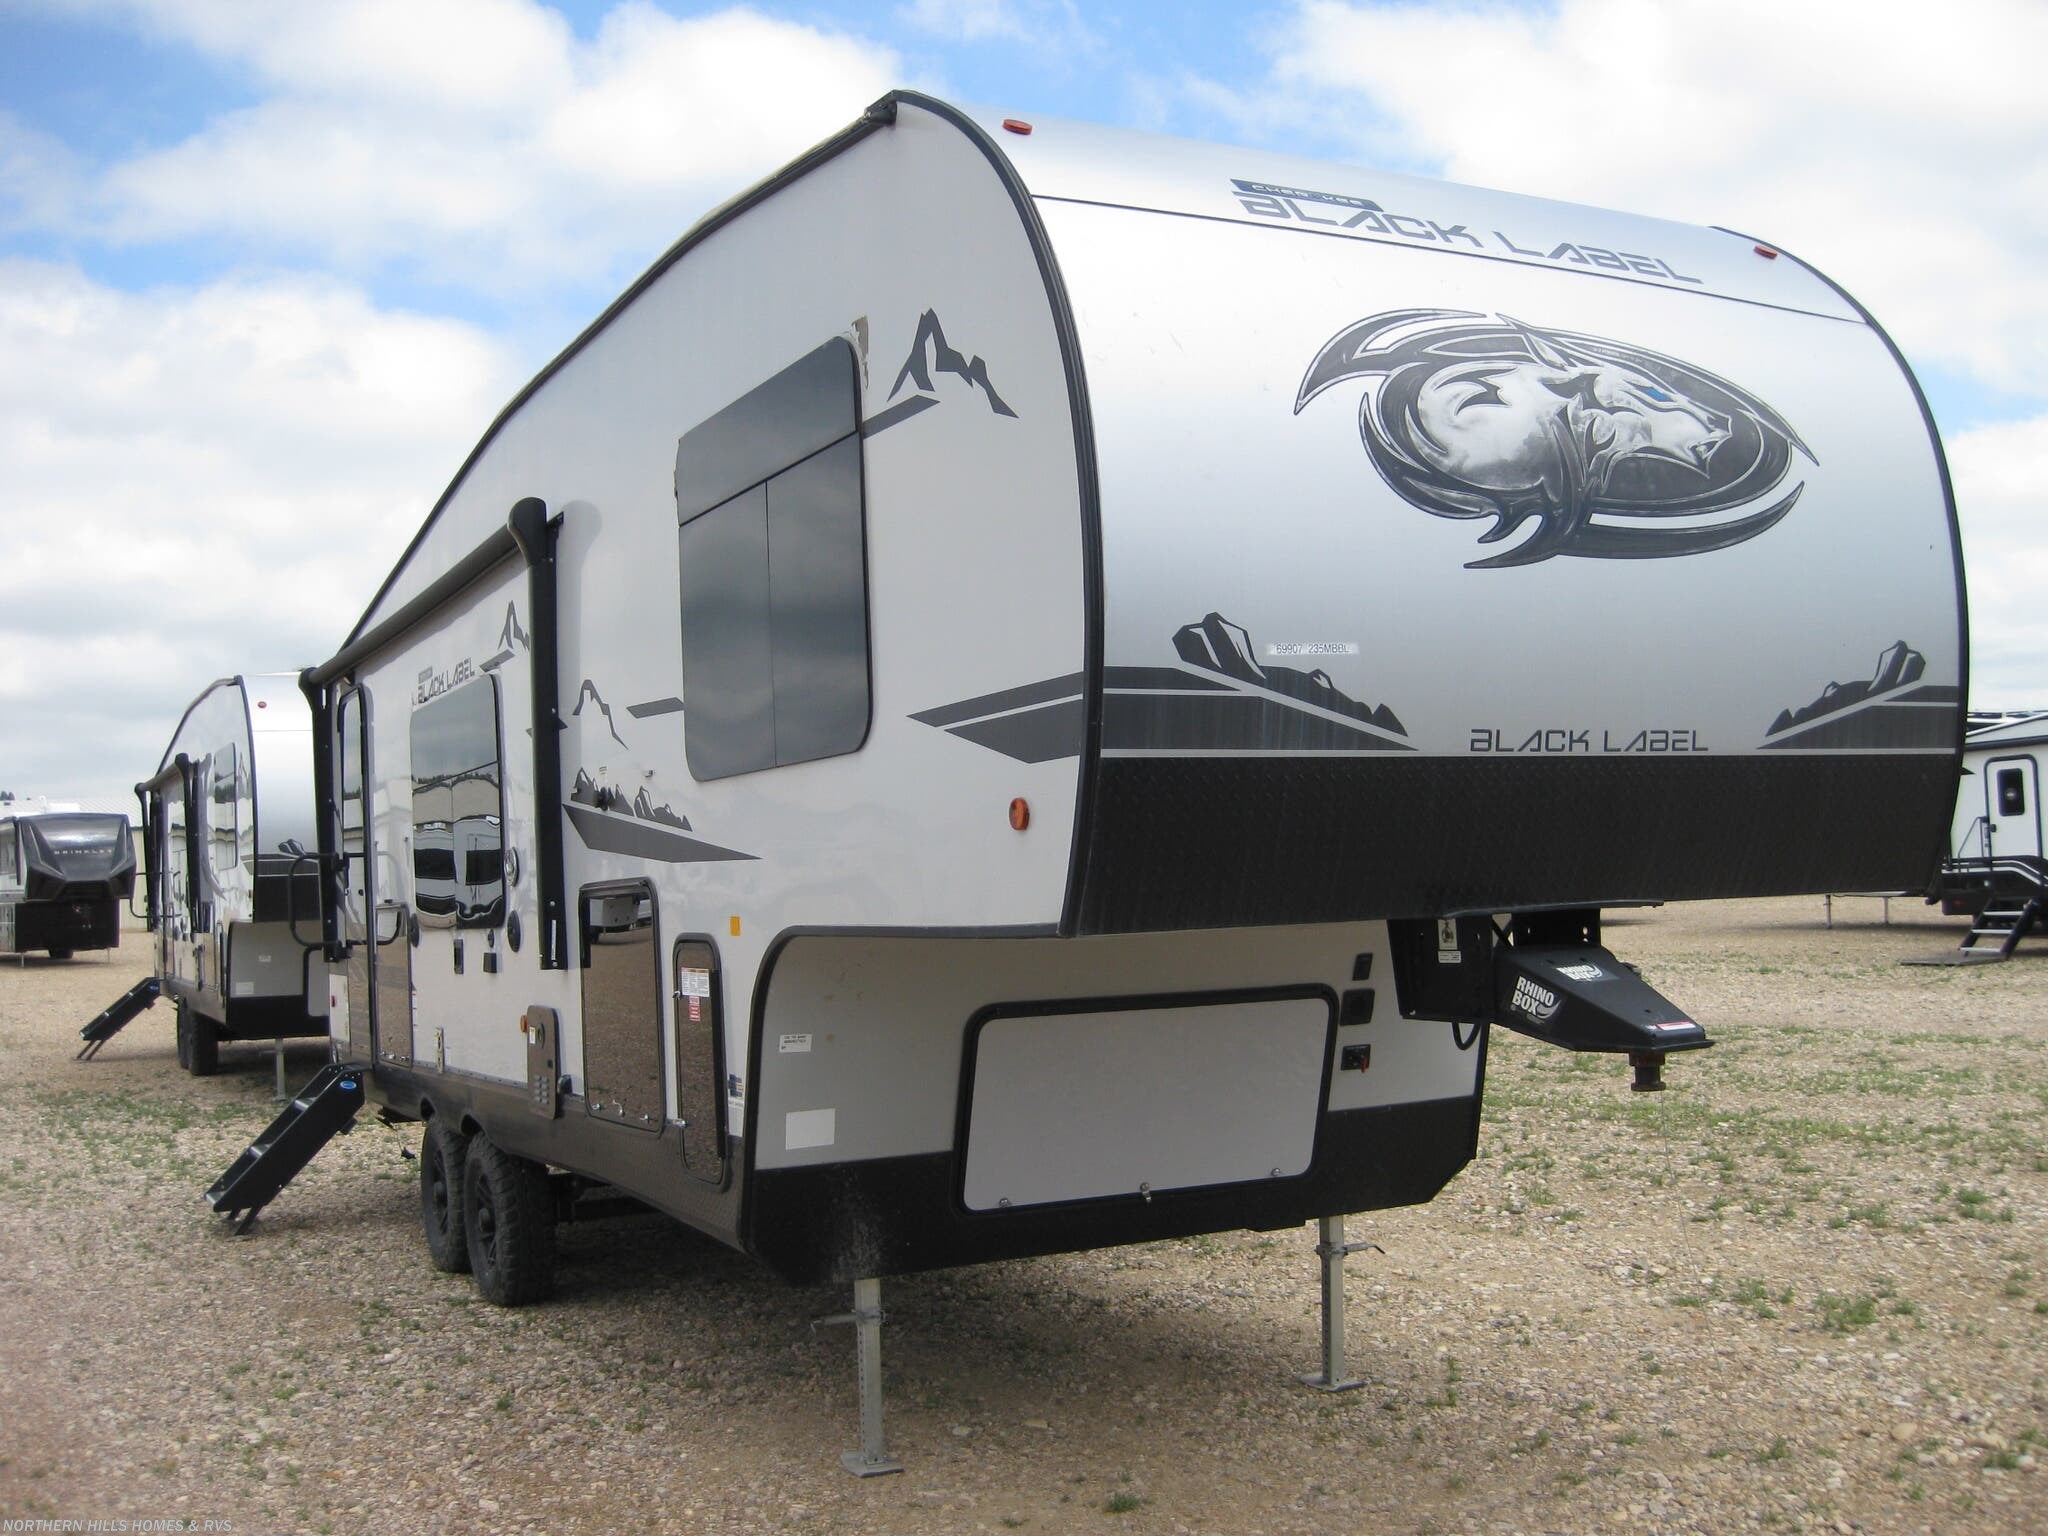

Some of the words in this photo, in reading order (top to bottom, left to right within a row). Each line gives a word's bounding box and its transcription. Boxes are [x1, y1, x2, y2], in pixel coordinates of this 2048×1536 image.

[1232, 190, 1484, 248] BLACK
[1493, 230, 1704, 284] LABEL
[1276, 643, 1303, 655] 69907
[418, 672, 447, 704] BLACK
[446, 657, 475, 689] LABEL
[1470, 728, 1590, 753] BLACK
[1603, 729, 1709, 753] LABEL
[1511, 989, 1540, 1016] BOX
[1516, 975, 1555, 1007] RHINO
